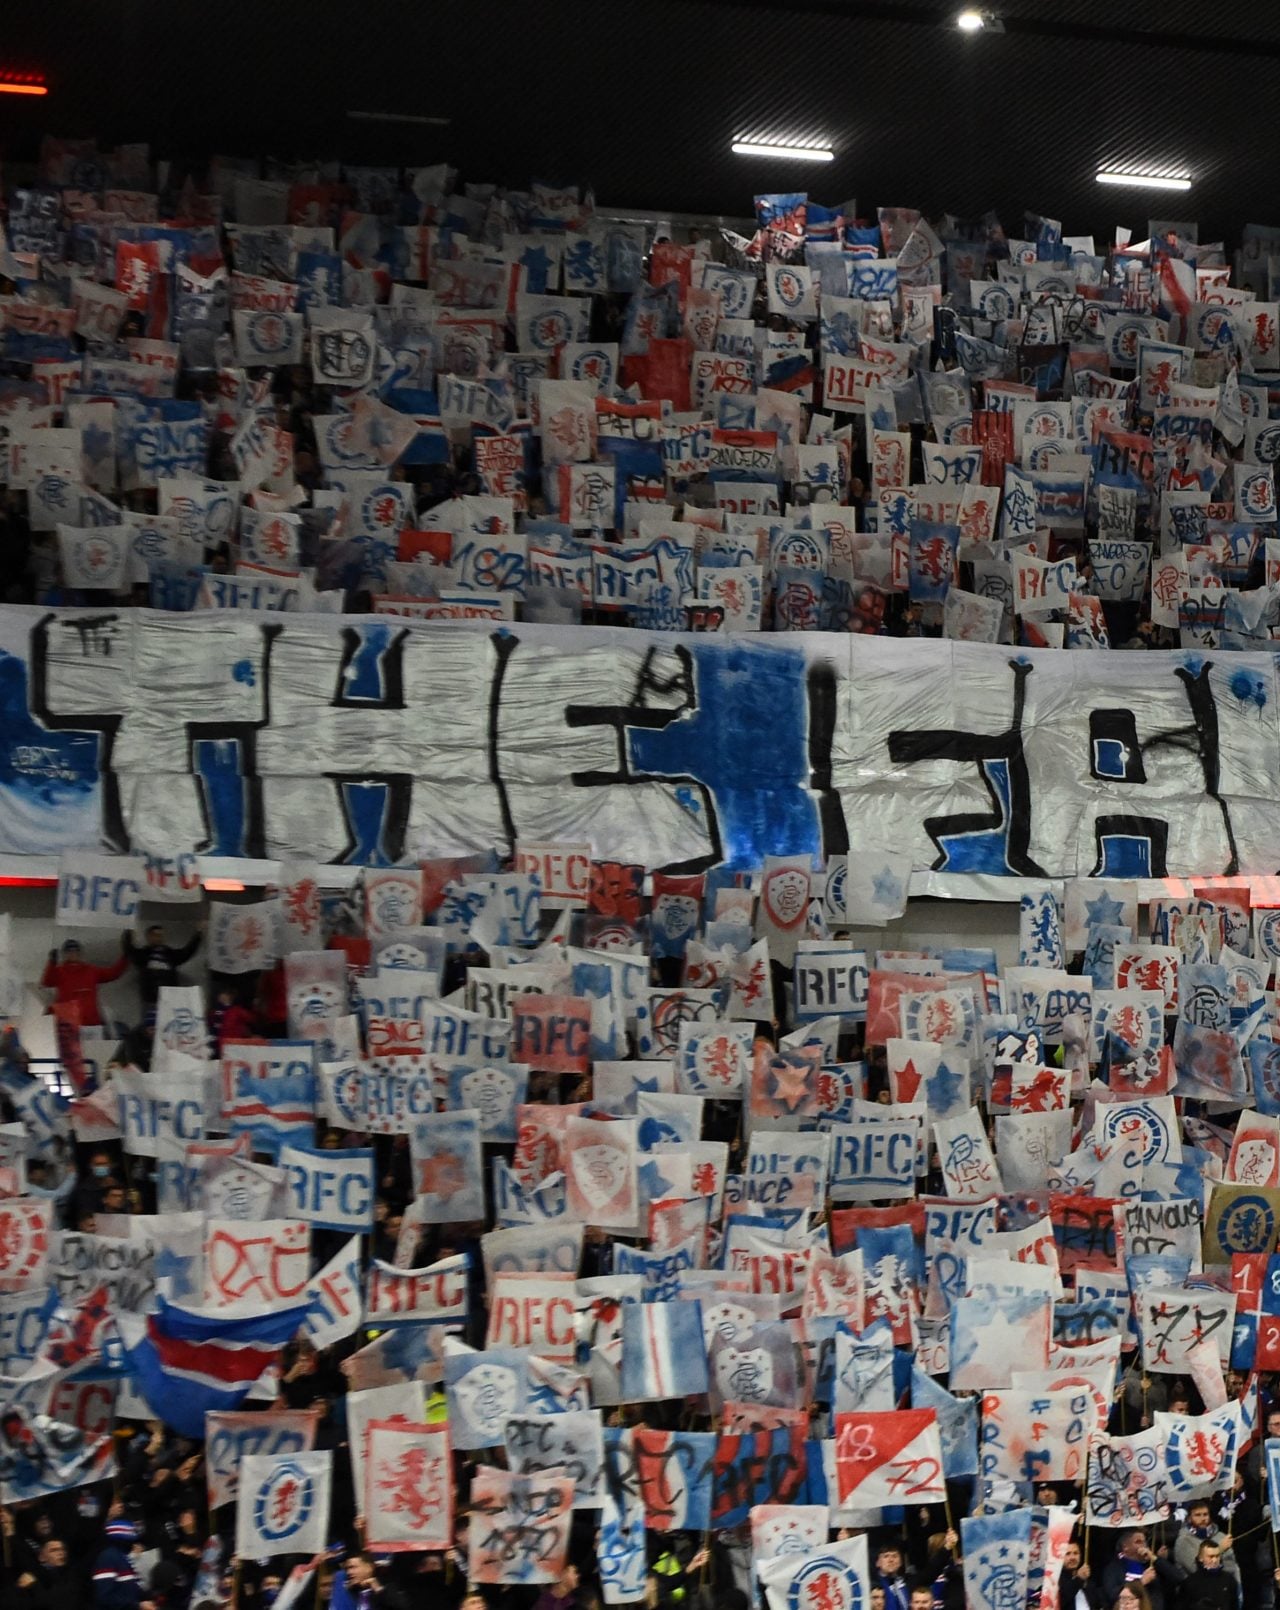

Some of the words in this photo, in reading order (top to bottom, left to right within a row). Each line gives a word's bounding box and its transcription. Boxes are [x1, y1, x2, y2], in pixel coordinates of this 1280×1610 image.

[597, 562, 657, 598] RFC
[1019, 560, 1080, 601] RFC
[28, 608, 728, 874] THE
[518, 853, 591, 892] RFC
[62, 872, 140, 917] RFC
[798, 966, 869, 1006] RFC
[431, 1015, 507, 1060] RFC
[515, 1015, 591, 1057] RFC
[121, 1094, 203, 1140] RFC
[833, 1133, 912, 1175] RFC
[285, 1163, 372, 1217] RFC
[724, 1175, 794, 1203] SINCE
[925, 1208, 994, 1246] RFC
[1127, 1200, 1203, 1233] FAMOUS
[369, 1271, 466, 1313] RFC
[752, 1252, 812, 1295] RF
[493, 1297, 576, 1347] RFC
[838, 1423, 877, 1465] 18
[885, 1456, 945, 1498] 72
